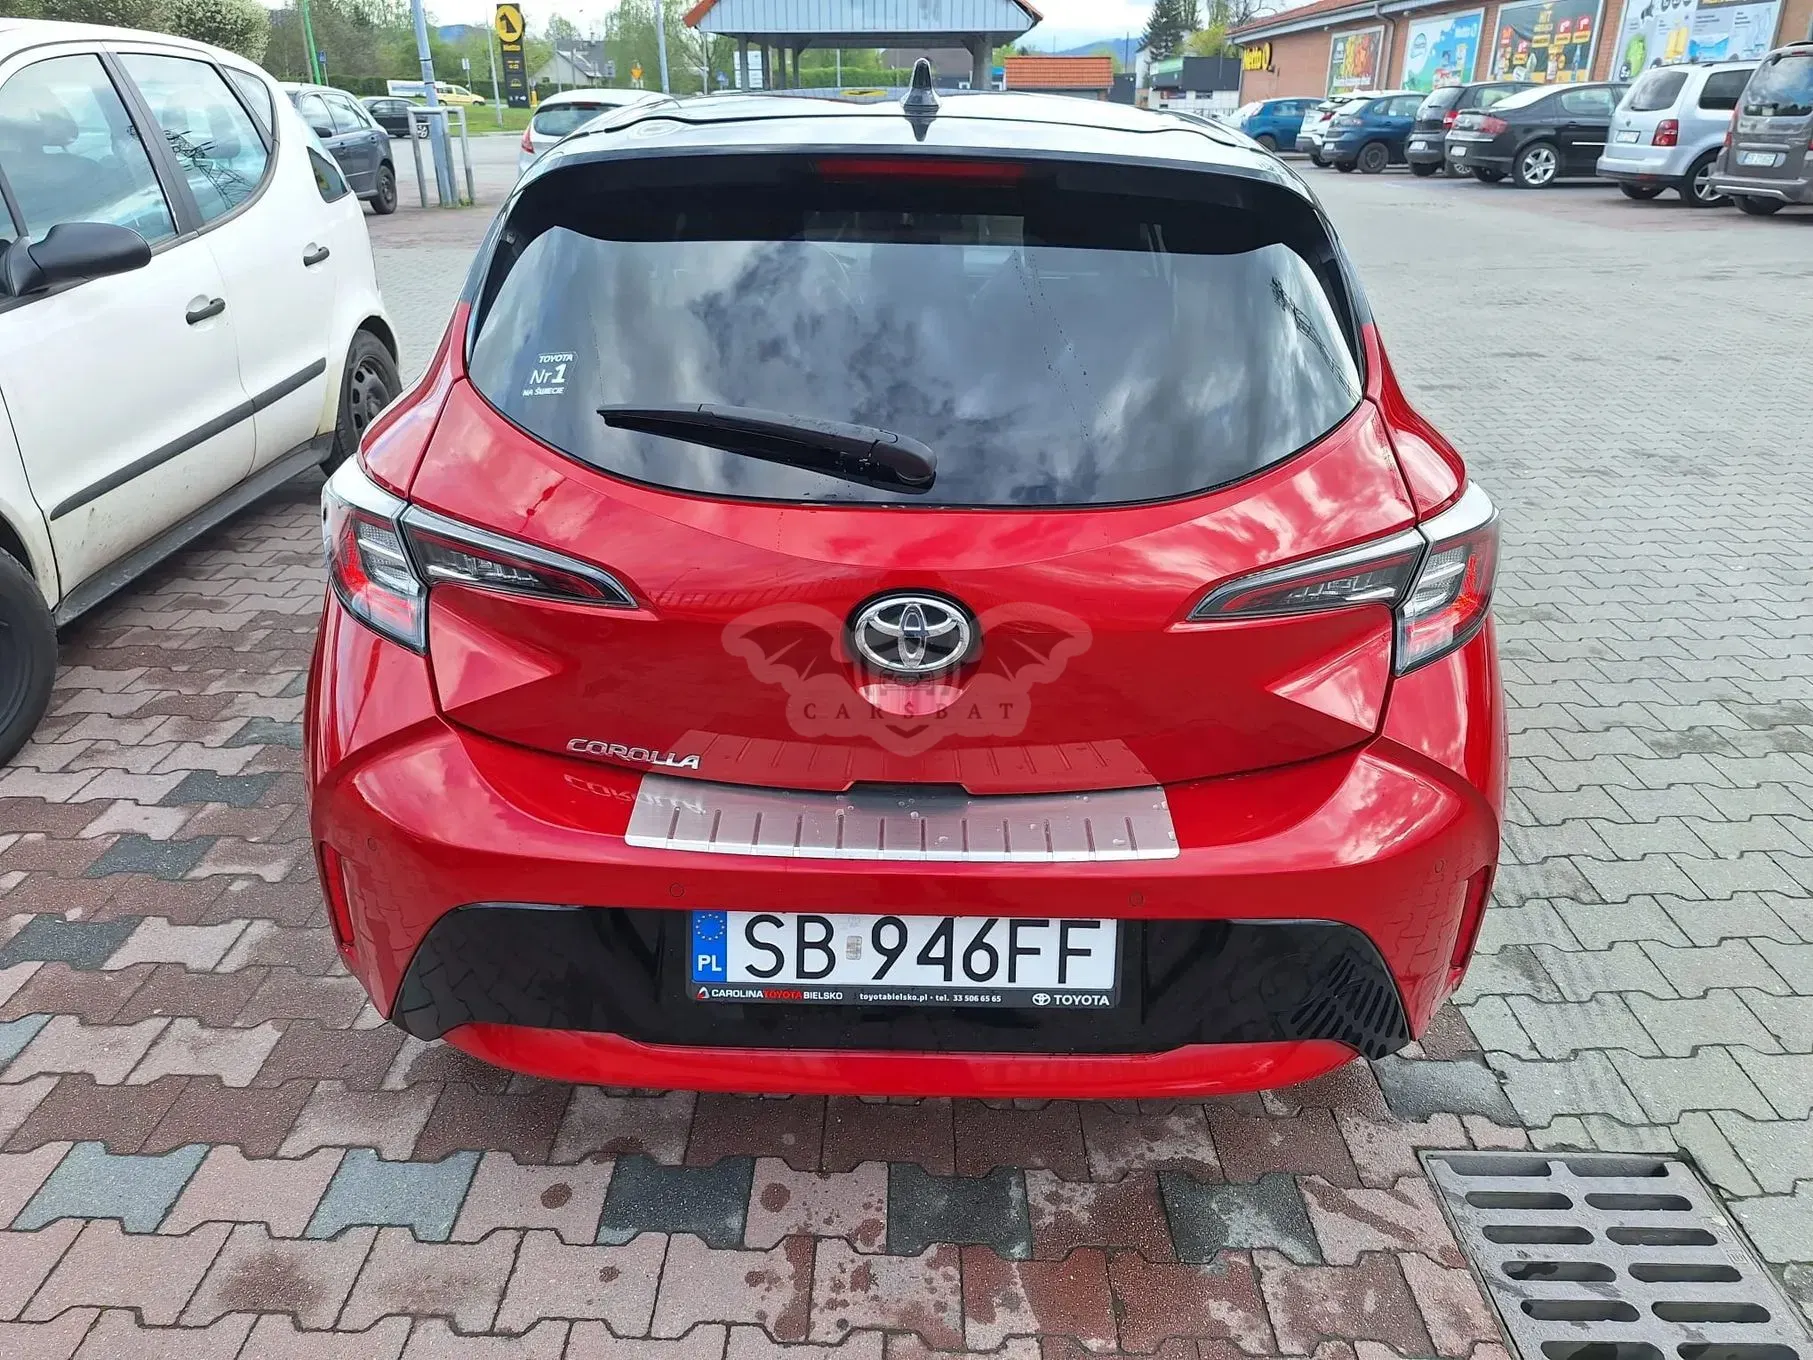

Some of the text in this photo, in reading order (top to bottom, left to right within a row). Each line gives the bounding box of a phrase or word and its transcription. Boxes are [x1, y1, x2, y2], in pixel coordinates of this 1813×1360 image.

[1243, 46, 1263, 70] Netto
[539, 353, 573, 363] TOYOTA
[566, 738, 701, 770] COROLLA
[744, 914, 1101, 984] SB 946FF
[697, 954, 722, 972] PL
[803, 991, 843, 1000] BIELSKO
[859, 992, 928, 1003] toyotabielsko.pl
[935, 994, 950, 1002] tel.
[1053, 994, 1110, 1006] TOYOTA
